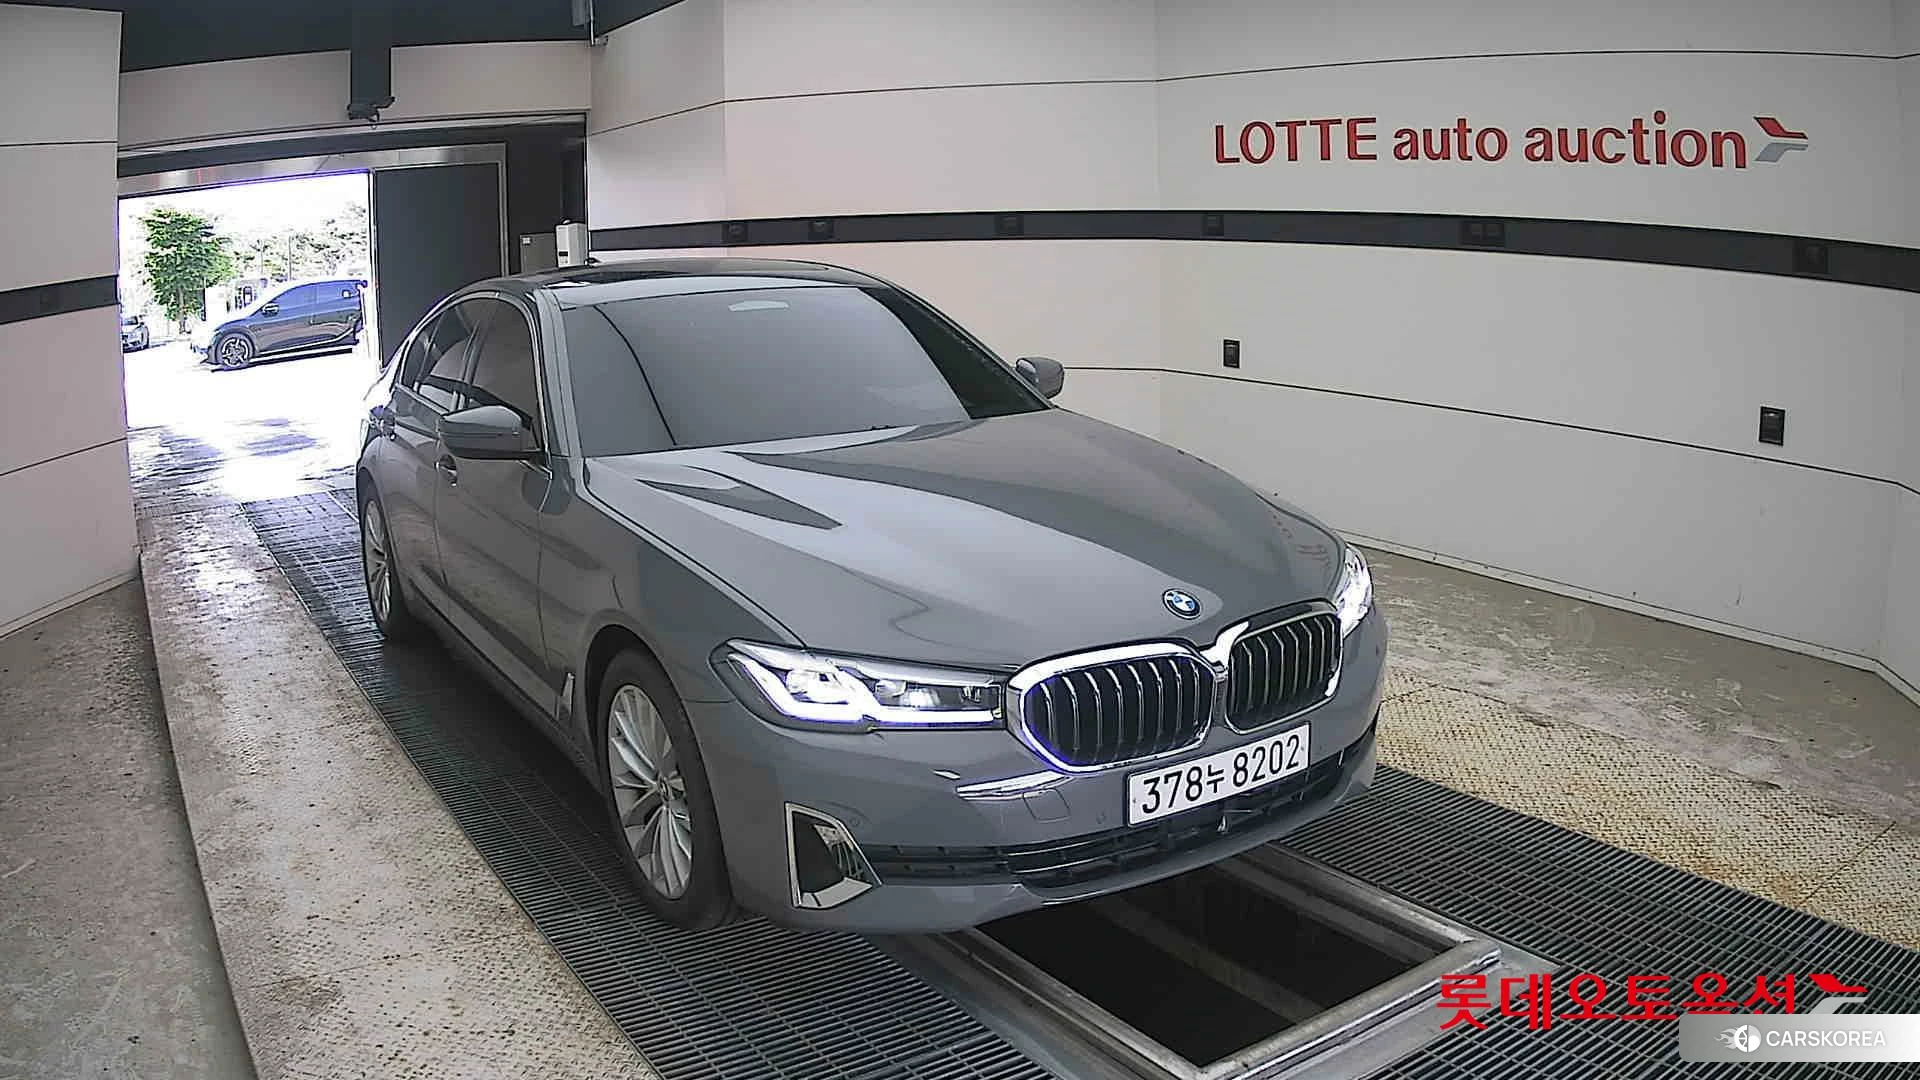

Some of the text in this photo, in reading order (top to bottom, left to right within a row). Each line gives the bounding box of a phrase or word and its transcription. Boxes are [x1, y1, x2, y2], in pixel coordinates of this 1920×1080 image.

[1214, 110, 1747, 169] LOTTE auto auction
[1232, 734, 1300, 788] 8202
